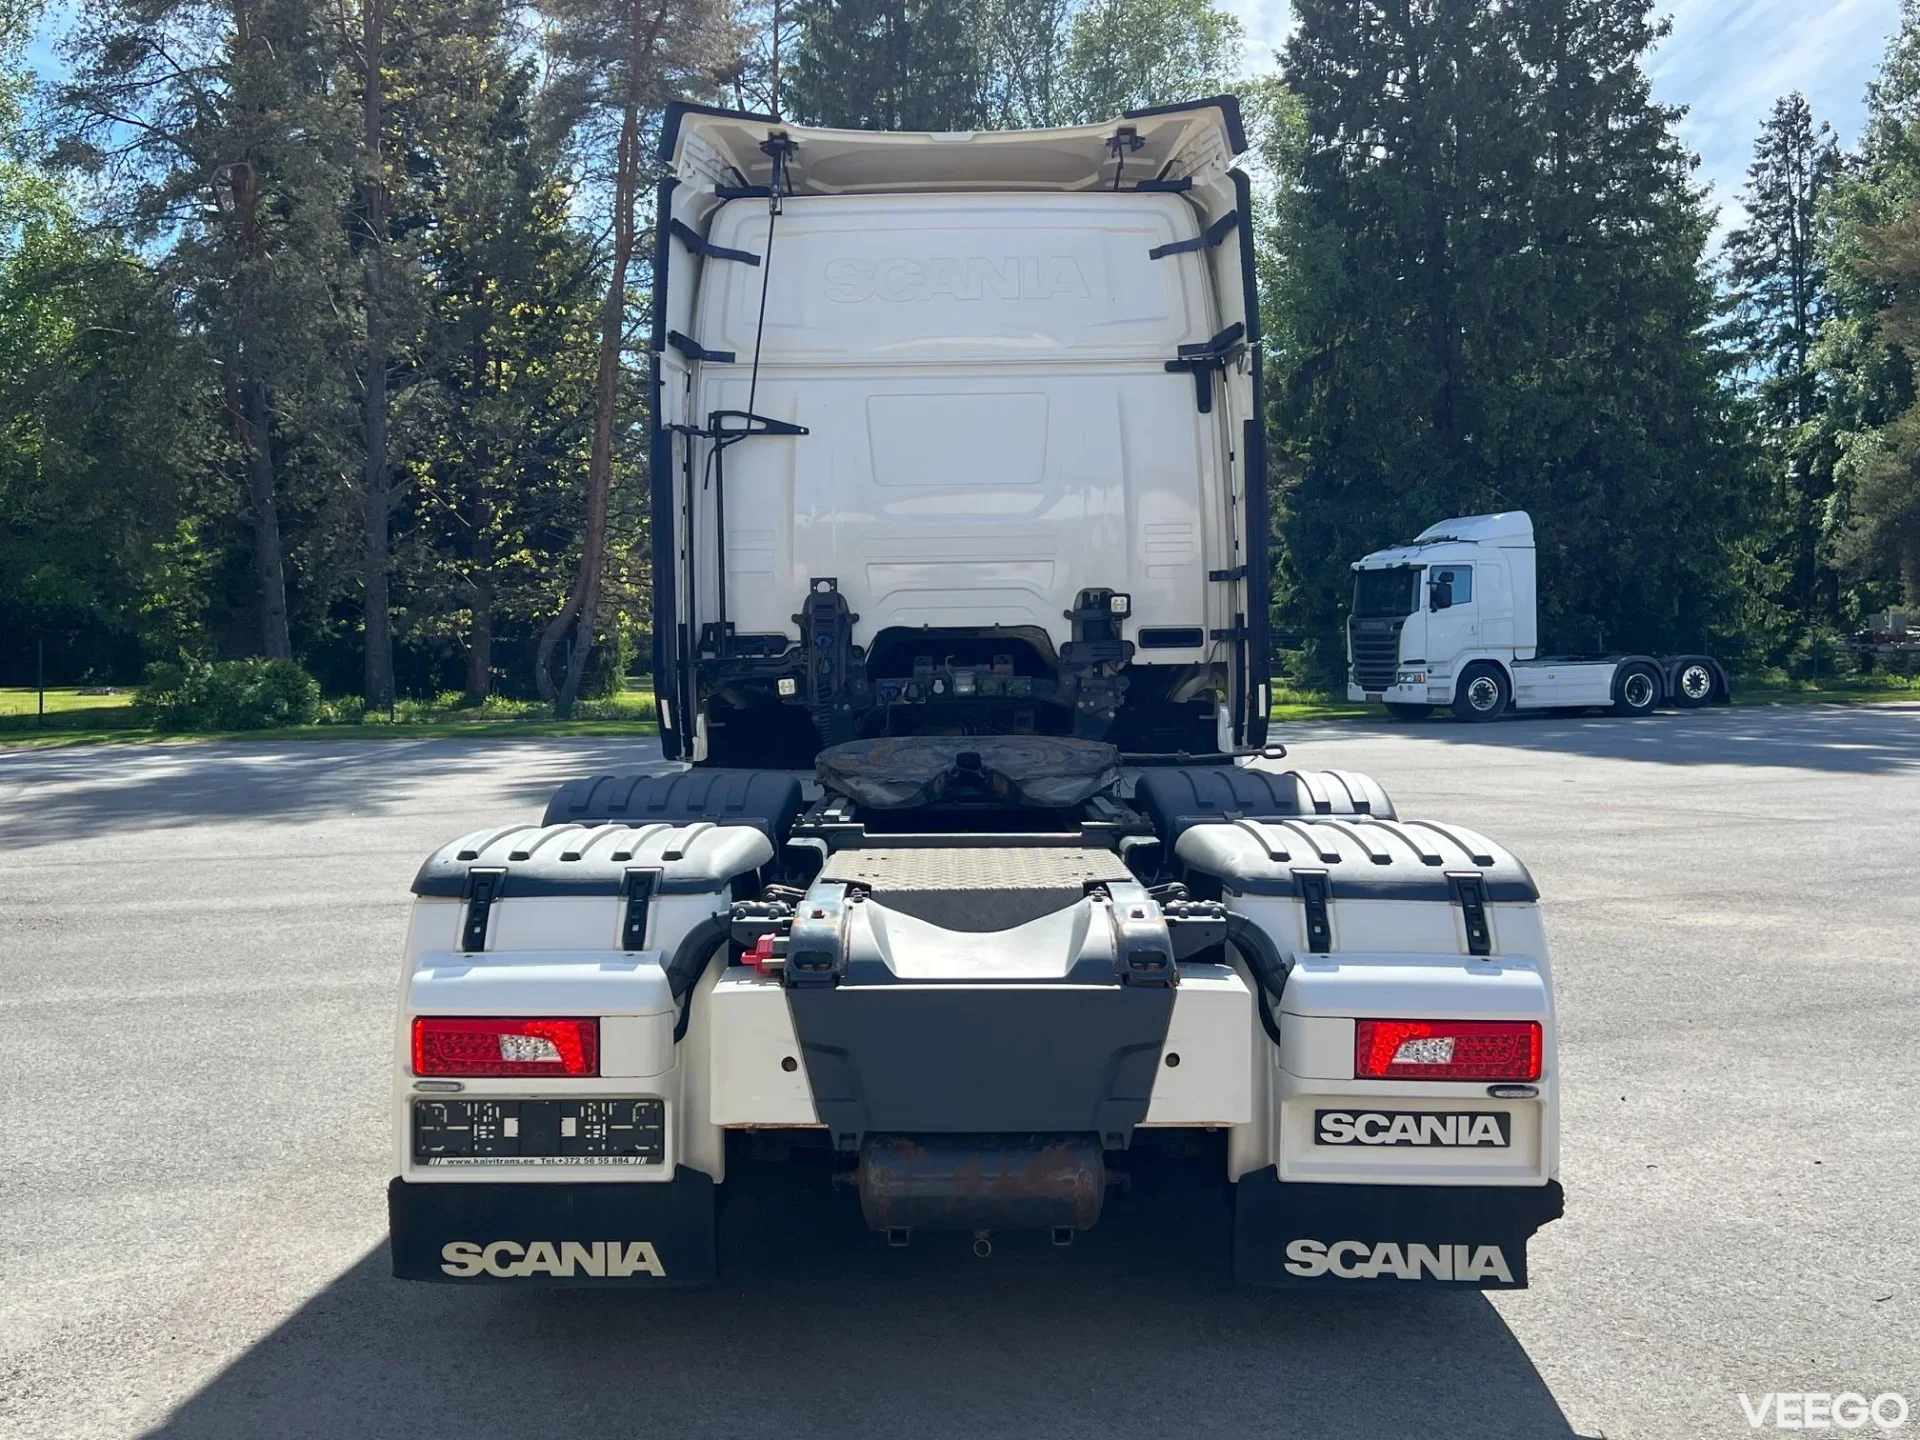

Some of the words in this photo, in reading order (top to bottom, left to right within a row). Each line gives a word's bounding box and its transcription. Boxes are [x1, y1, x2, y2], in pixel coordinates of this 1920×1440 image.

[823, 256, 1091, 303] SCANIA
[1320, 1112, 1505, 1145] SCANIA
[583, 1157, 595, 1165] 56
[598, 1157, 609, 1165] 55
[441, 1241, 666, 1277] SCANIA
[1284, 1239, 1514, 1282] SCANIA
